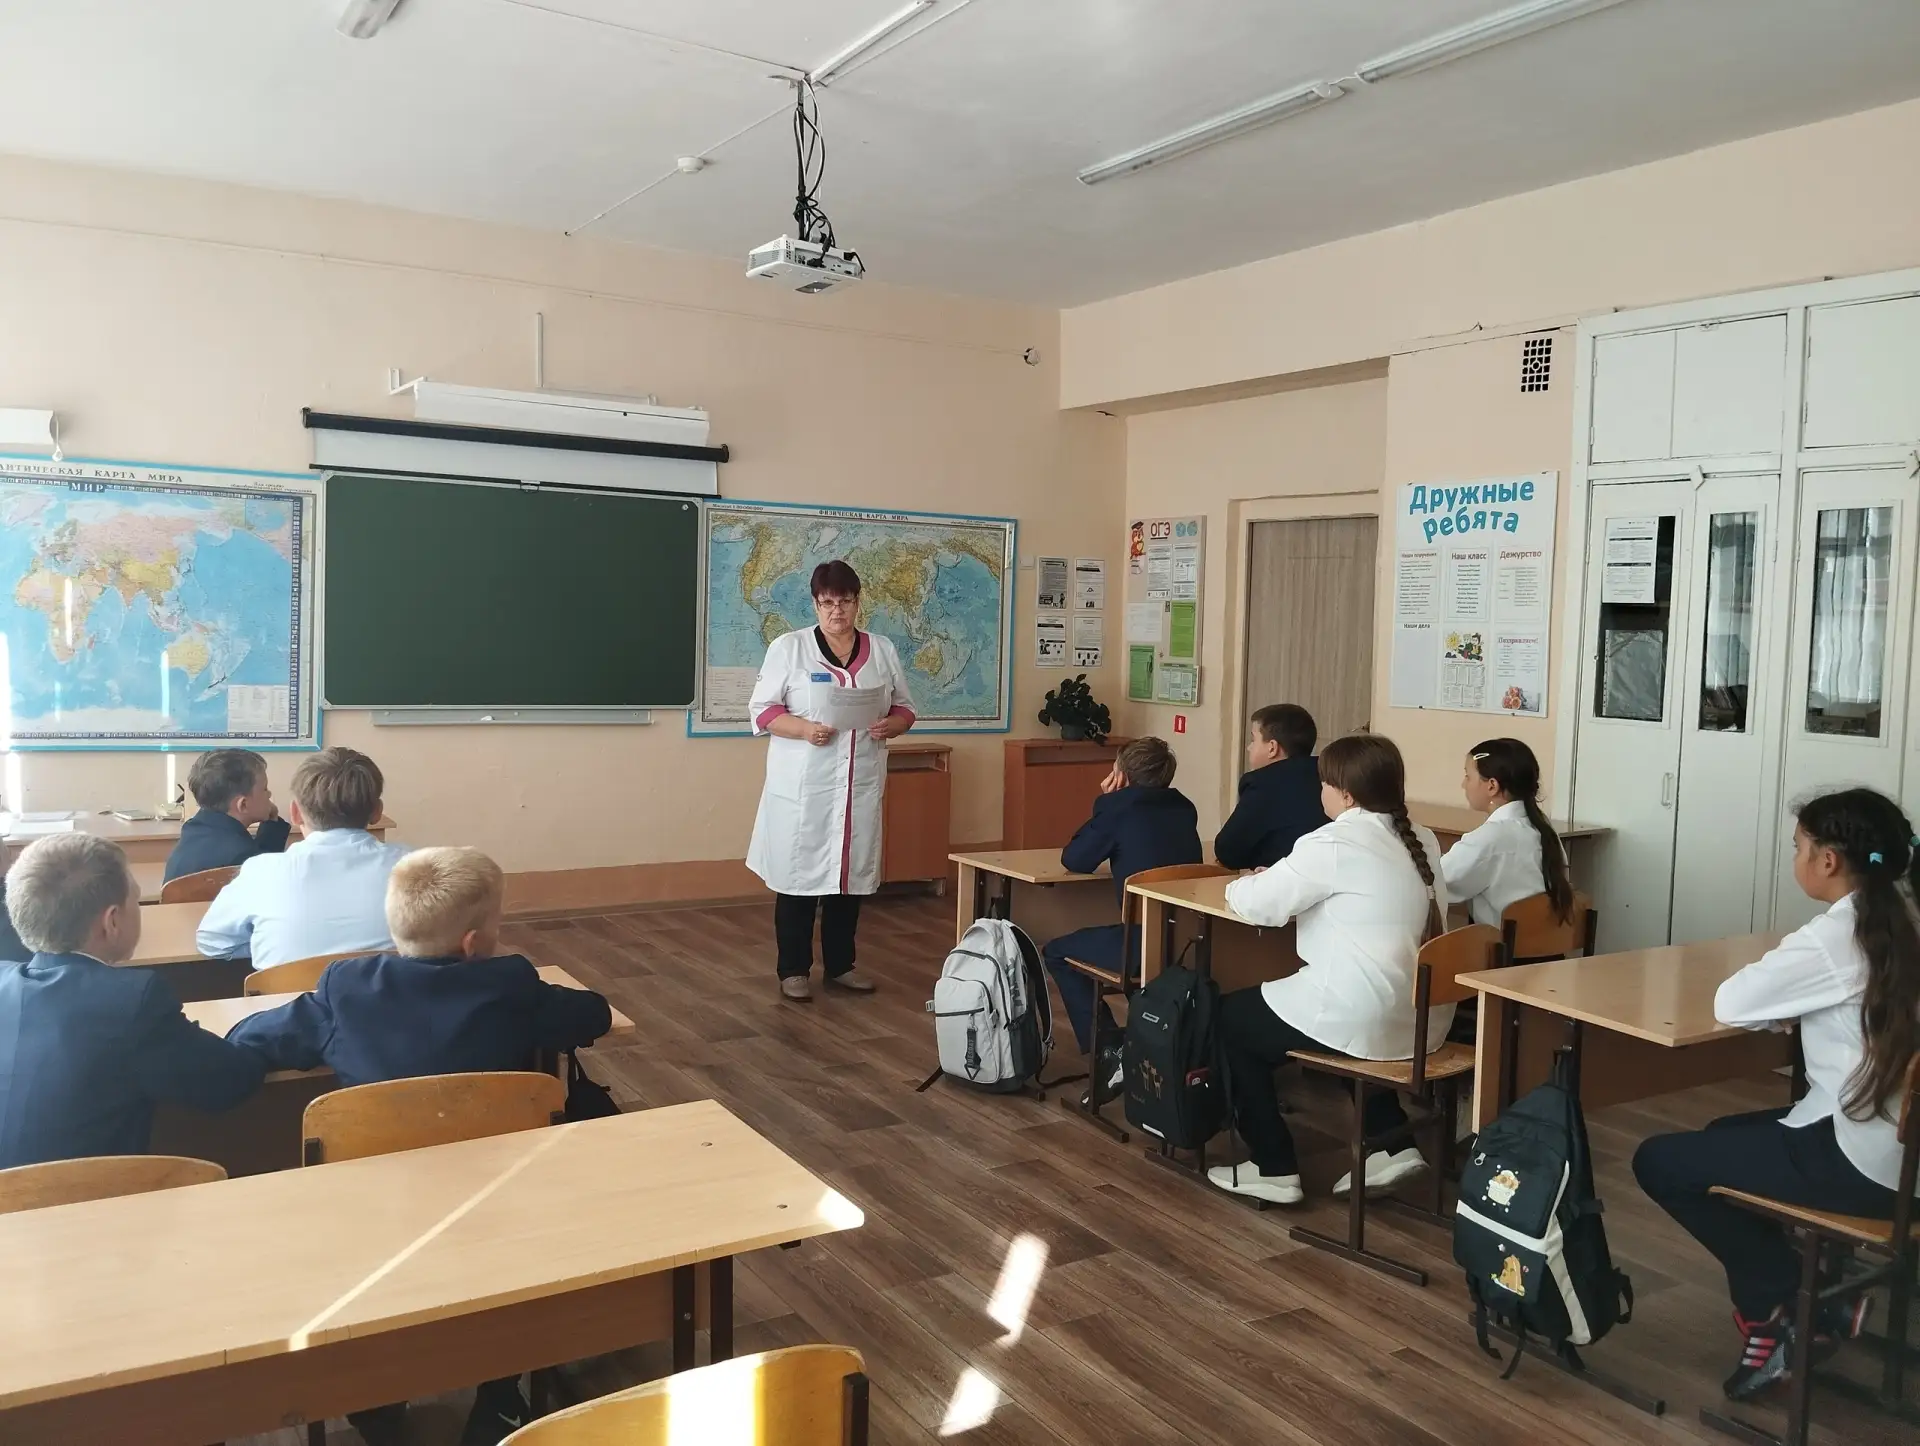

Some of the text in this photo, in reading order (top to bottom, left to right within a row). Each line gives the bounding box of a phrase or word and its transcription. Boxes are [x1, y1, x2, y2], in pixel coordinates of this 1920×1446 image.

[95, 470, 136, 479] КАРТА
[148, 473, 183, 482] МИРА
[71, 482, 104, 492] МИР
[1409, 481, 1534, 515] Дружные
[819, 510, 862, 518] ФИЗИЧЕСКАЯ
[1151, 522, 1170, 536] ОГЭ
[1423, 506, 1519, 543] ребята
[1500, 551, 1542, 560] Дежурство
